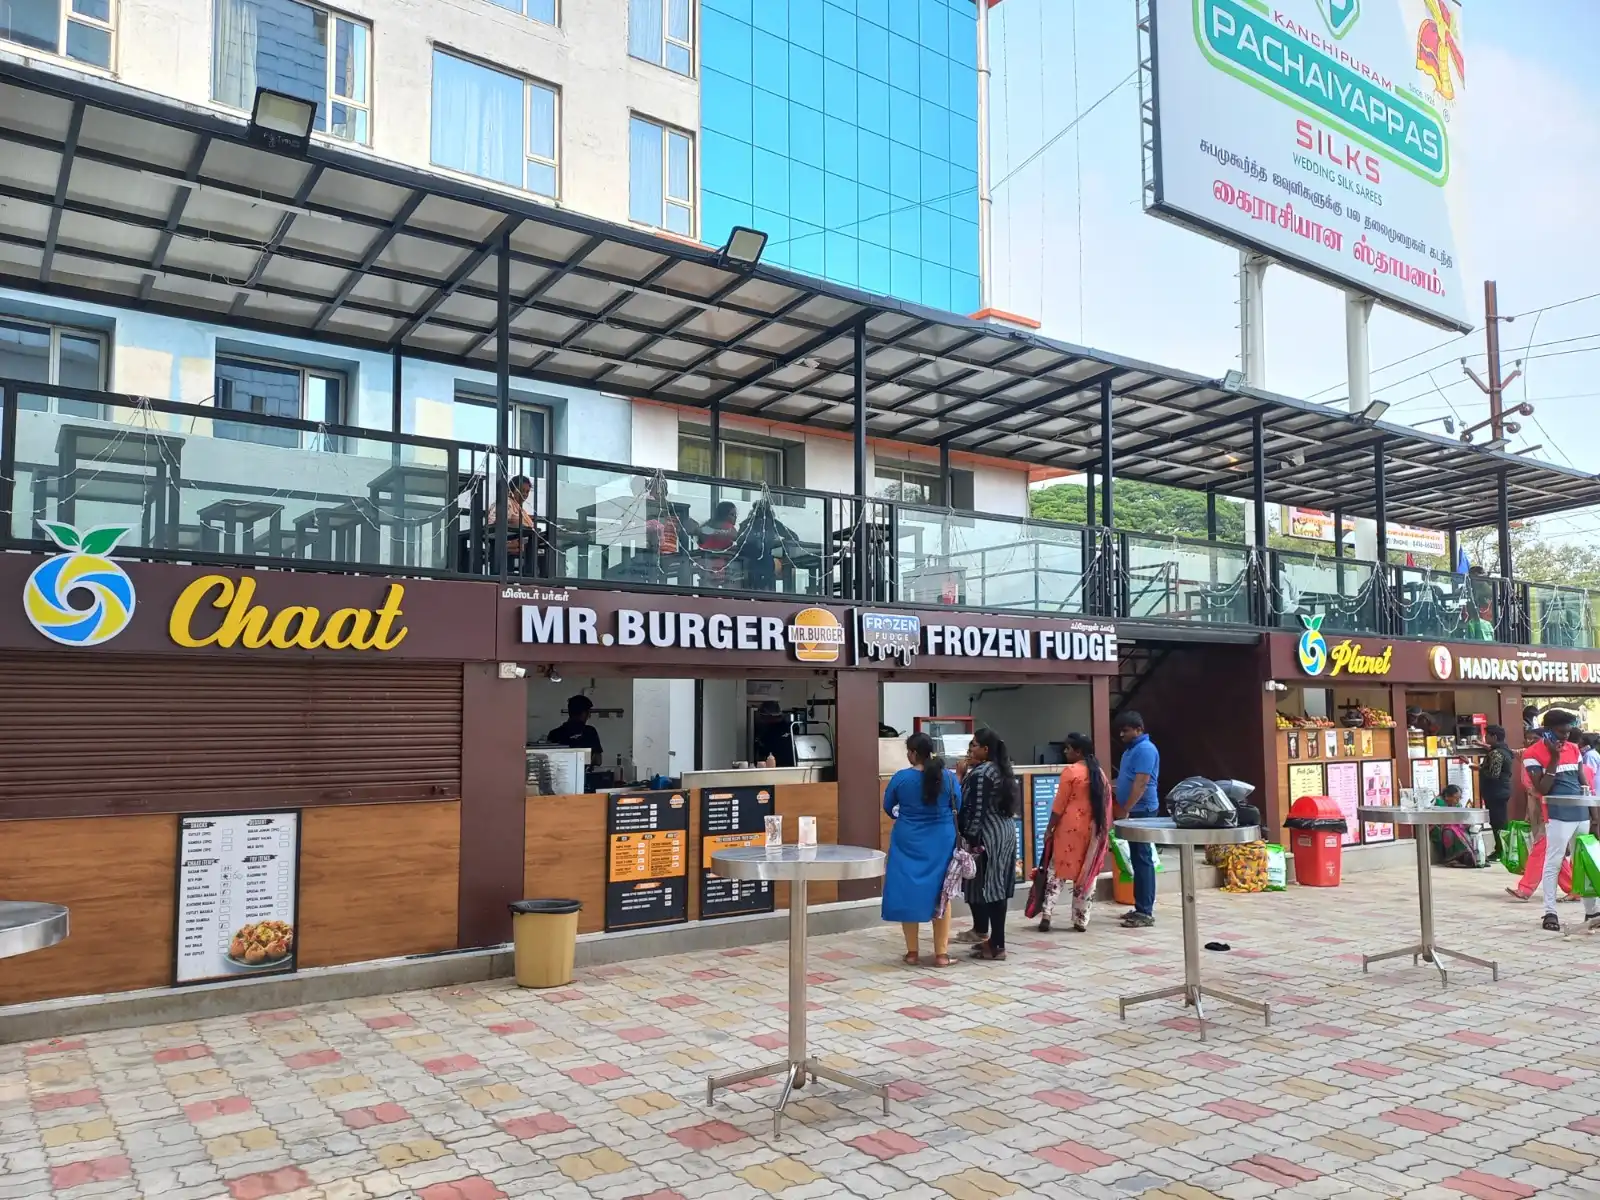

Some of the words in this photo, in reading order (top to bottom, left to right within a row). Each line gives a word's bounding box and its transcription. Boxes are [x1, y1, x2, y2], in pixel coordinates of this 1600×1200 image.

[1274, 10, 1392, 91] KANCHIPURAM
[1212, 5, 1439, 161] PACHAIYAPPAS
[1296, 120, 1381, 184] SILKS
[1292, 152, 1336, 183] WEDDING
[1337, 174, 1354, 192] SILK
[1355, 180, 1383, 206] SAREES
[1213, 179, 1344, 252] கைராசியான
[1353, 234, 1446, 297] ஸ்தாபனம்.
[1272, 173, 1343, 216] ஜவுளிகளுக்கு
[1346, 206, 1361, 222] பல
[1364, 216, 1426, 254] தலைமுறைகள்
[1429, 247, 1453, 268] கடந்த
[169, 574, 408, 651] Chaat
[502, 588, 540, 600] மிஸ்டர்
[541, 590, 570, 601] பர்கர்
[521, 604, 786, 650] MR.BURGER
[789, 626, 844, 643] MR.BURGER
[866, 617, 917, 631] FROZEN
[875, 632, 909, 641] FUDGE
[926, 625, 1031, 658] FROZEN
[1040, 630, 1118, 661] FUDGE
[1330, 639, 1392, 677] Planet
[1459, 656, 1519, 681] MADRAS
[1521, 660, 1569, 683] COFFEE
